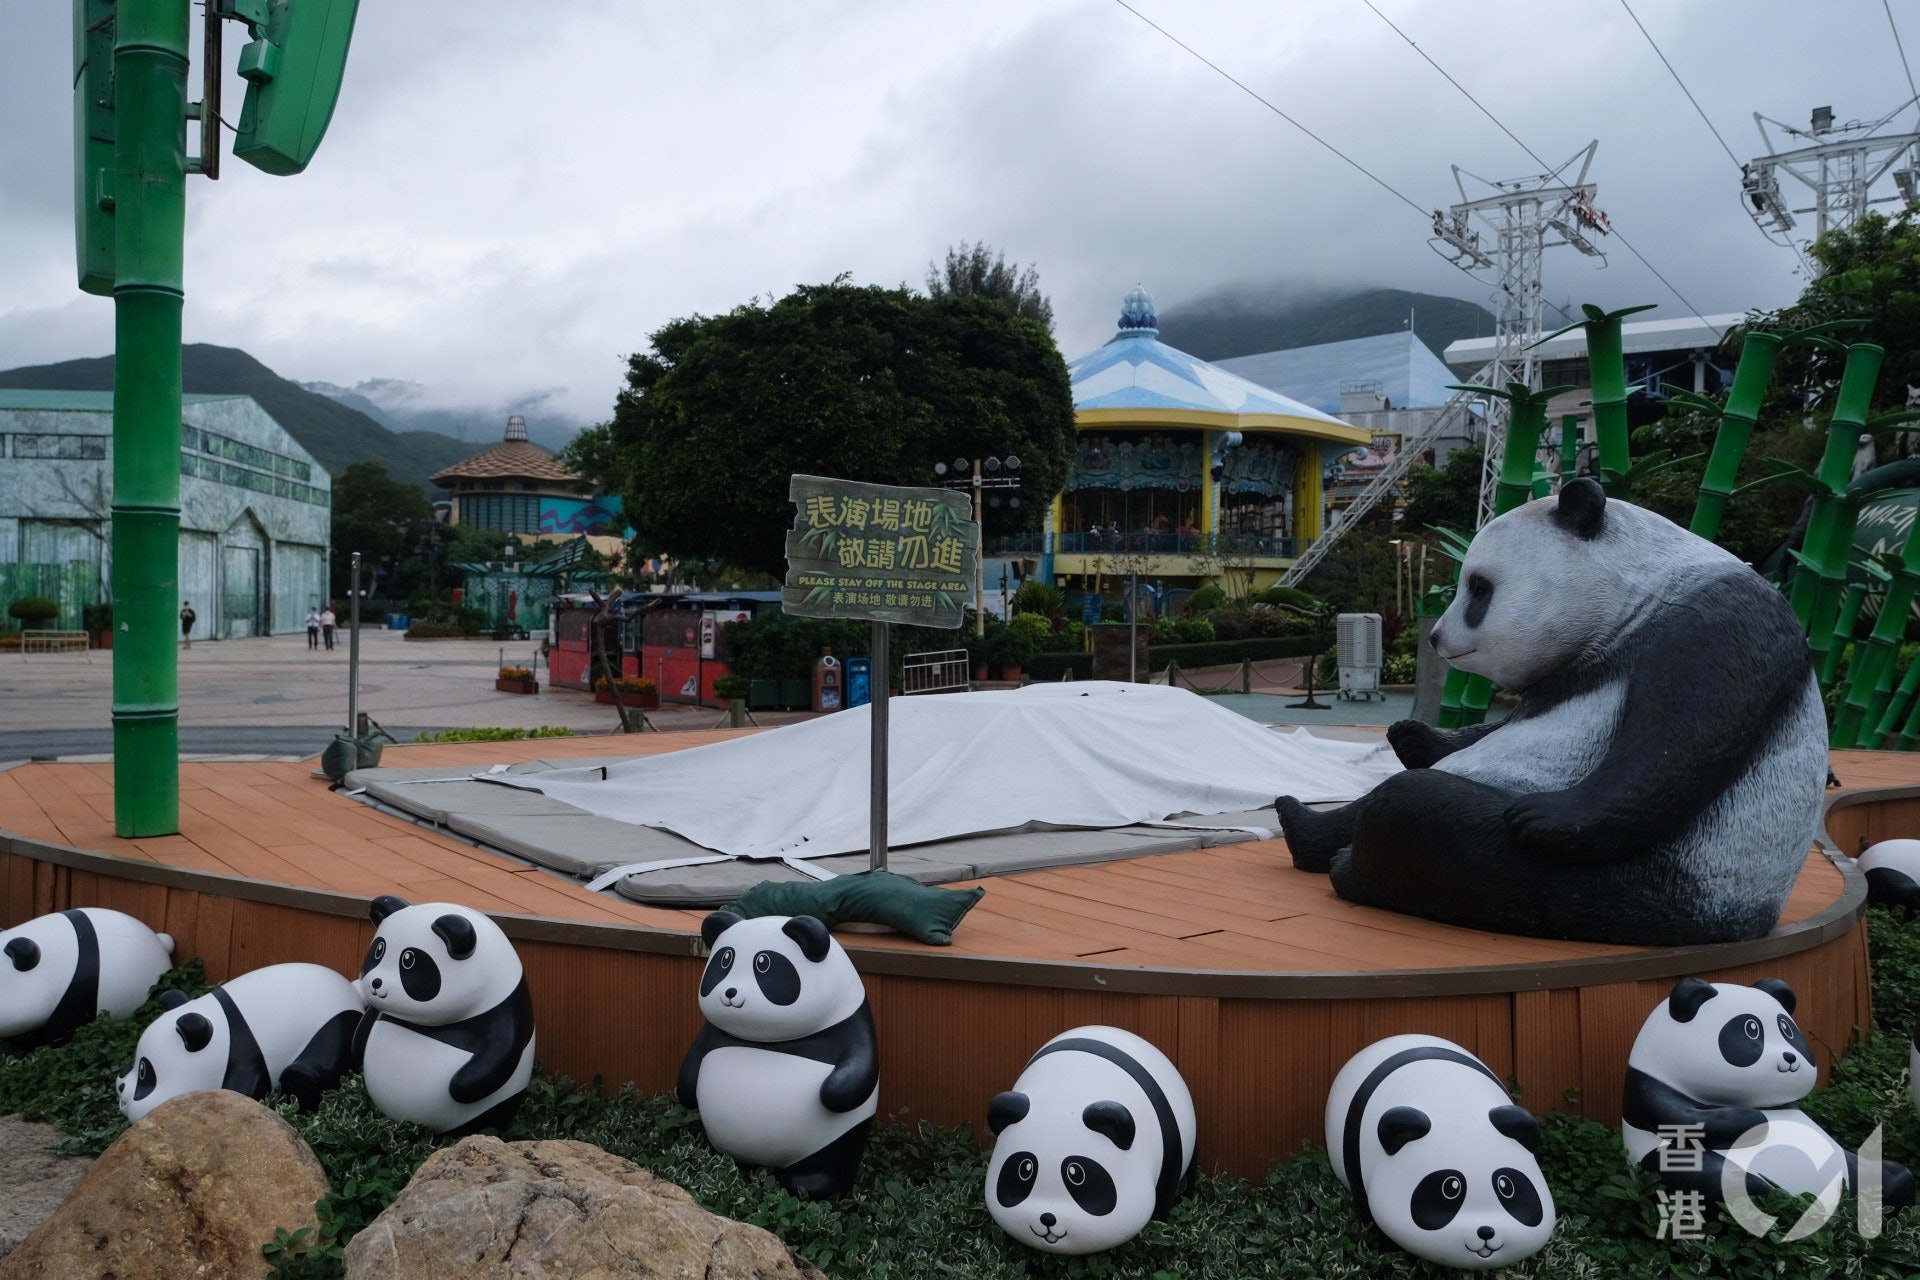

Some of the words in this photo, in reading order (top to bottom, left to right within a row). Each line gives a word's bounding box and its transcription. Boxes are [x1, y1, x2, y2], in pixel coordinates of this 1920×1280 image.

[806, 495, 932, 533] 表演場地
[837, 535, 964, 574] 敬請勿進
[799, 577, 835, 586] PLEASE
[838, 578, 862, 587] STAY
[865, 579, 884, 588] OFF
[886, 580, 904, 589] THE
[906, 581, 938, 590] STAGE
[940, 582, 967, 591] AREA
[833, 592, 881, 606] 表演场地
[885, 593, 932, 608] 敬请勿进
